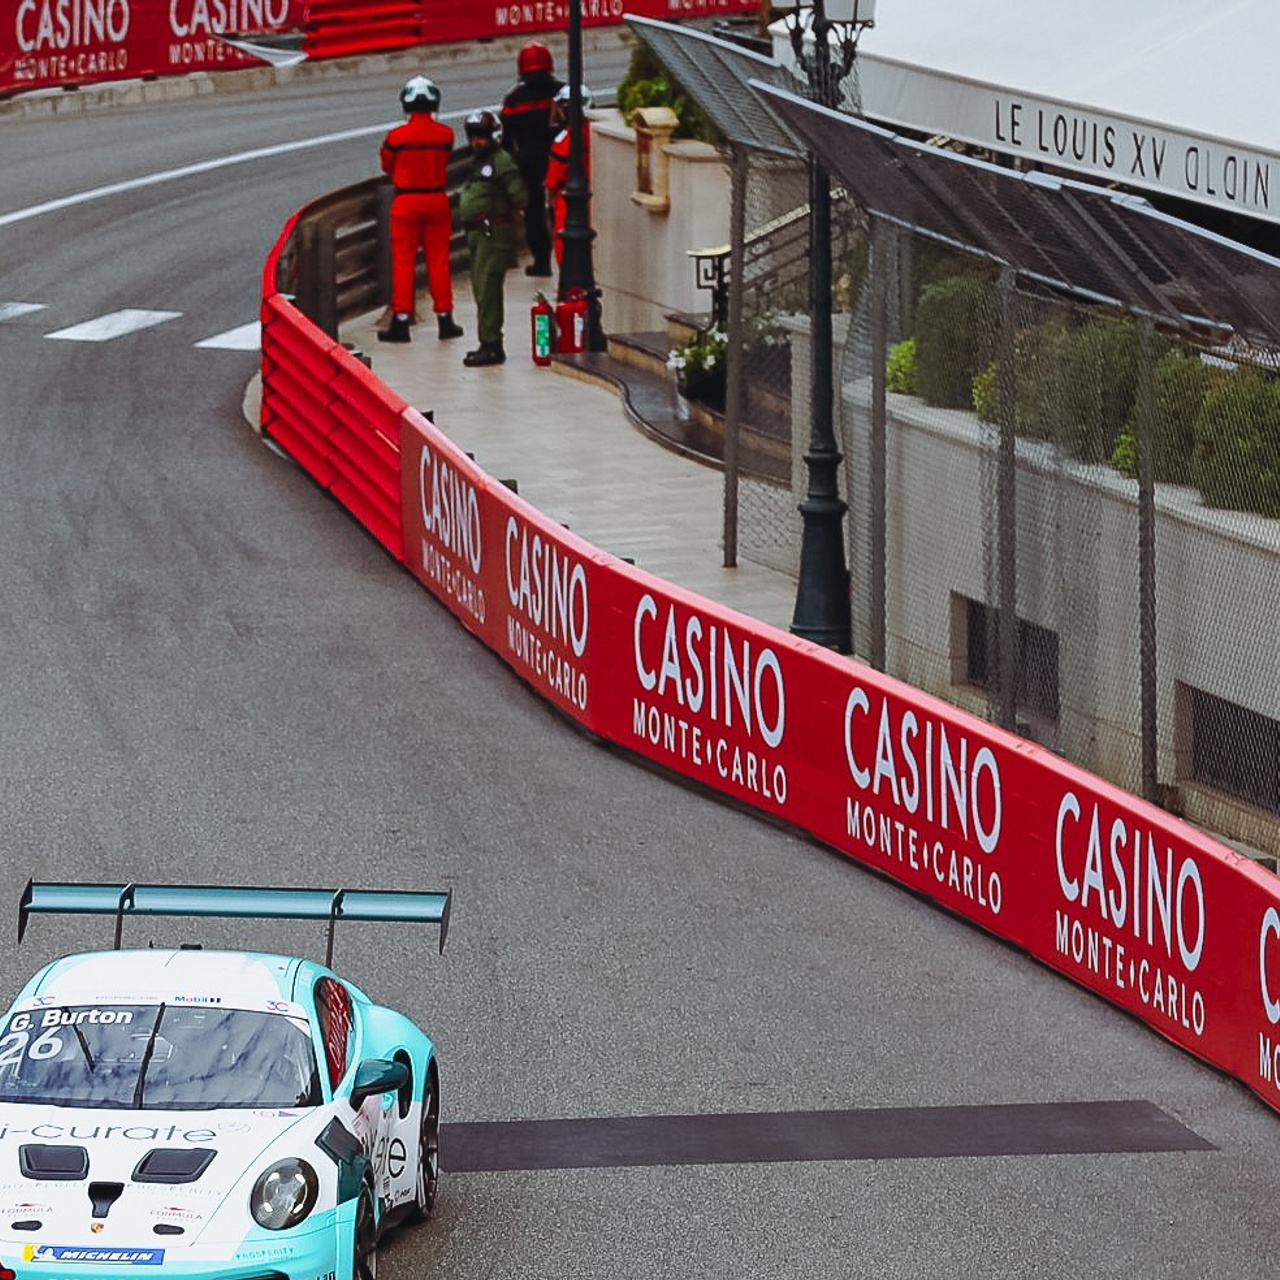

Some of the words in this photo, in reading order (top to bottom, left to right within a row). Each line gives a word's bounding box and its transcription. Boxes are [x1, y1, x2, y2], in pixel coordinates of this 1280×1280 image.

[15, 0, 130, 52] CASINO
[77, 48, 128, 74] CARLO
[171, 39, 223, 64] MONTE
[995, 100, 1022, 146] LE
[1038, 110, 1115, 168] LOUIS
[1131, 132, 1166, 180] XV
[420, 444, 482, 574] CASINO
[422, 538, 452, 595] MONTE
[505, 515, 588, 657] CASINO
[507, 614, 543, 677] MONTE
[546, 649, 588, 712] CARLO
[633, 593, 785, 749] CASINO
[633, 697, 702, 767] MONTE
[716, 737, 787, 805] CARLO
[845, 686, 1002, 854] CASINO
[846, 796, 919, 871] MONTE
[932, 841, 1002, 915] CARLO
[1055, 792, 1205, 972] CASINO
[10, 1011, 34, 1031] G.
[41, 1009, 134, 1028] Burton
[1056, 910, 1125, 990] MONTE
[1138, 958, 1205, 1036] CARLO
[0, 1123, 218, 1142] i-curate
[61, 1250, 154, 1262] MICHELIN
